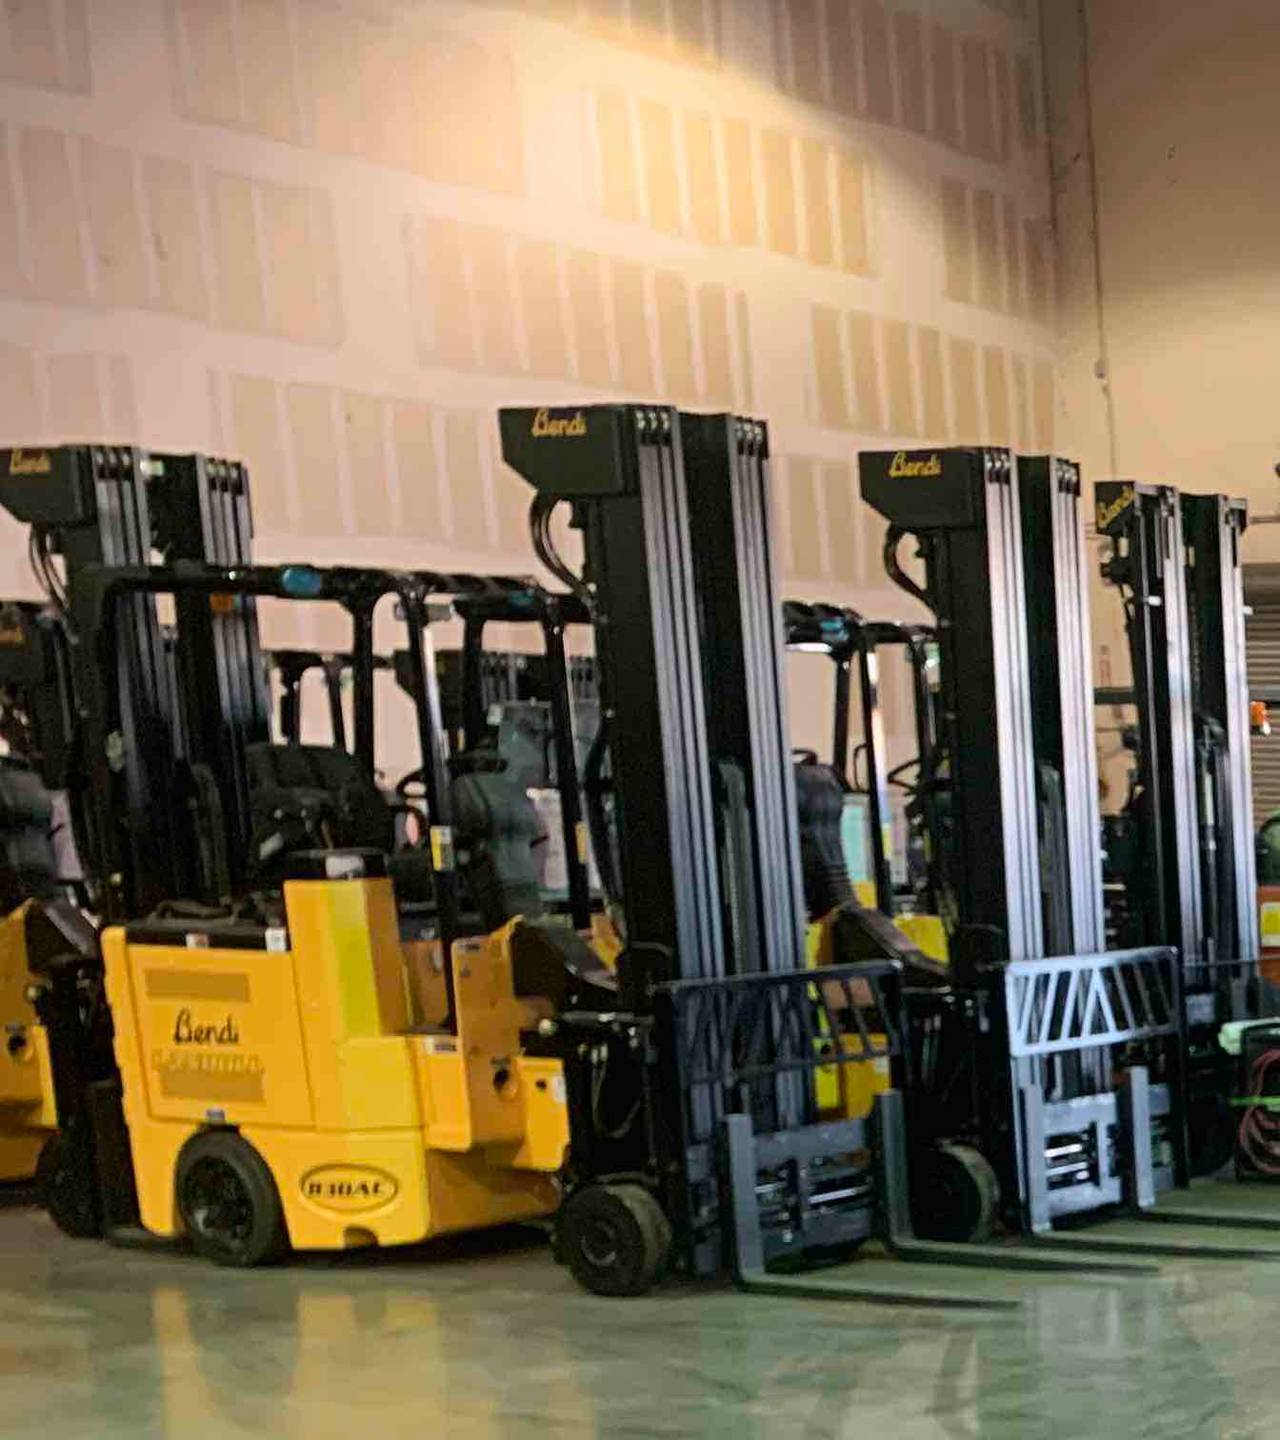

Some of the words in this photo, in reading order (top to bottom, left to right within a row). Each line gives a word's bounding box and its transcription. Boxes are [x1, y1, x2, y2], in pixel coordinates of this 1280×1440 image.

[532, 406, 587, 437] Bendi
[889, 449, 941, 477] Bendi
[173, 1006, 240, 1045] Bendi
